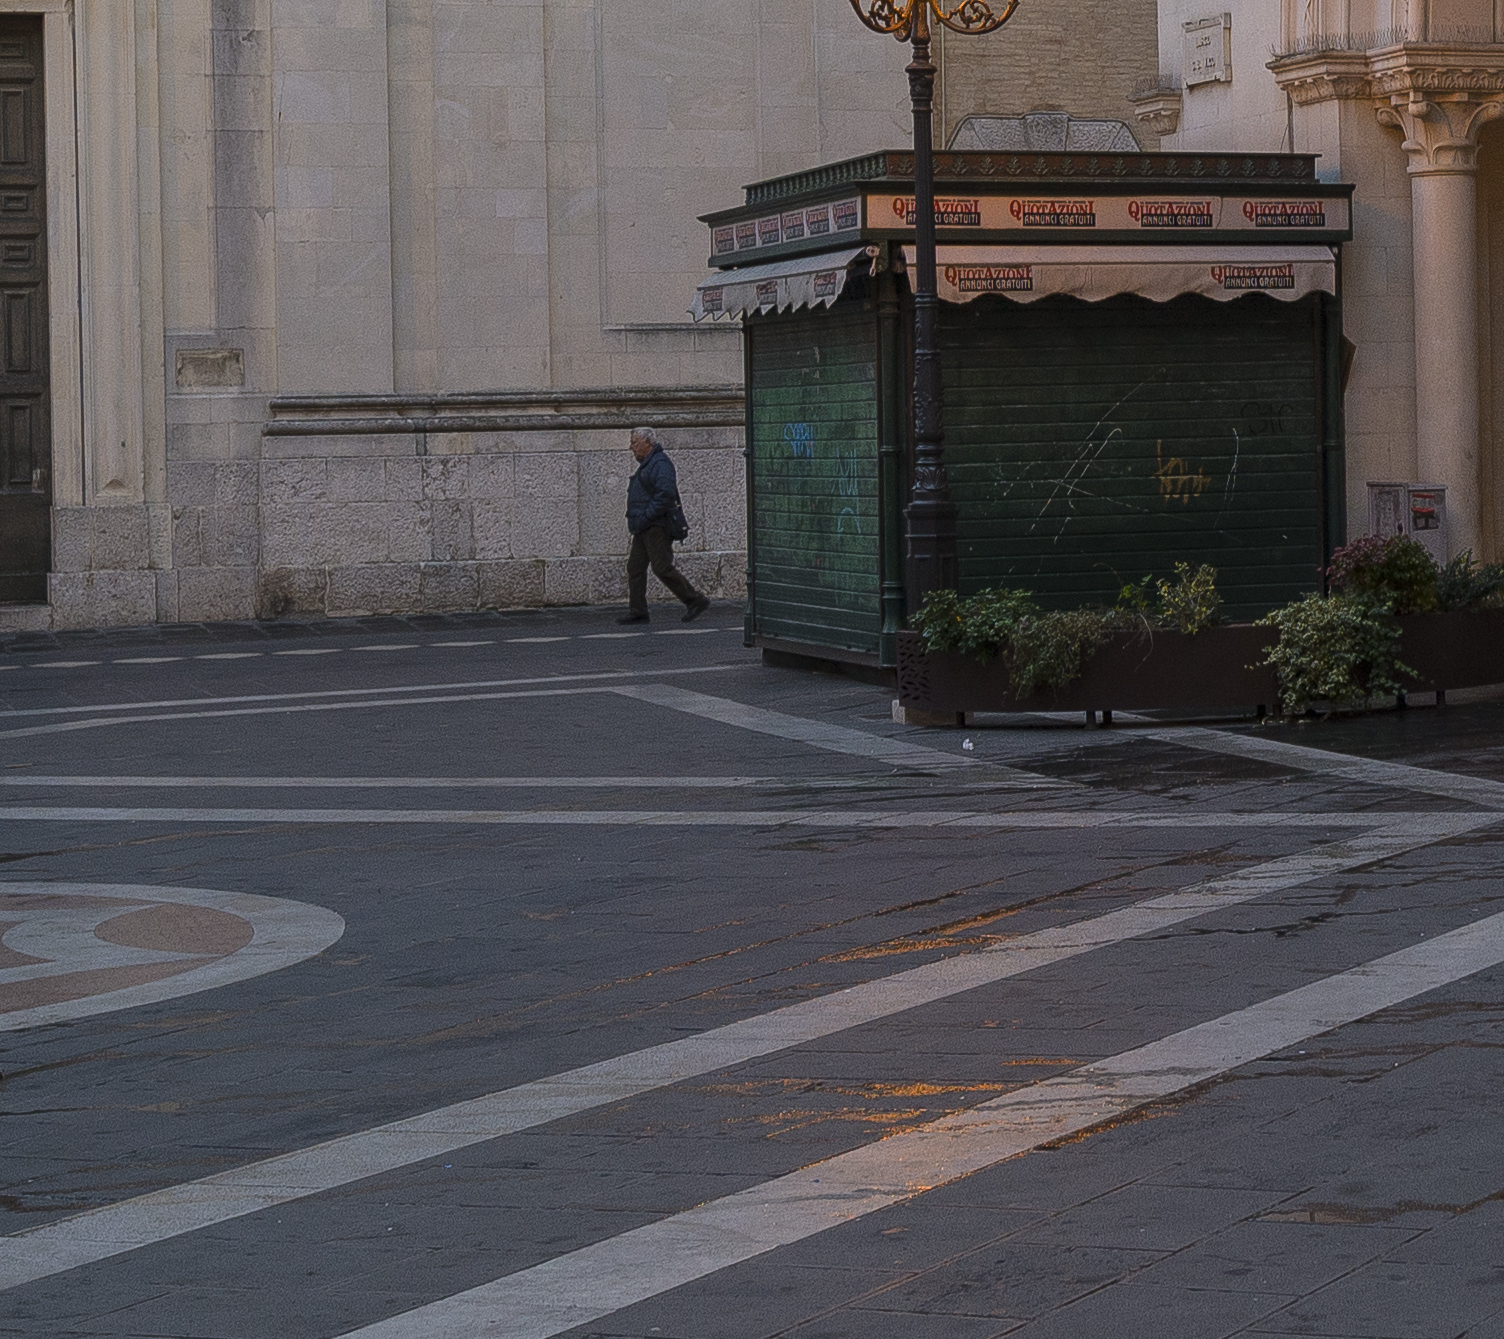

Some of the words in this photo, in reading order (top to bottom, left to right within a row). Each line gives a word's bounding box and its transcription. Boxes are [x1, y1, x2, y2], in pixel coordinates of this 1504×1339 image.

[943, 213, 979, 224] GRATUITI
[1024, 214, 1058, 226] ANNUNCI
[1058, 214, 1094, 226] GRATUITI
[1141, 215, 1175, 226] ANNUNCI
[1175, 215, 1211, 226] GRATUITI
[1256, 215, 1289, 226] ANNUNCI
[1289, 215, 1324, 226] GRATUITI
[959, 279, 995, 291] ANNUNCI
[995, 279, 1031, 290] GRATUITI
[1224, 277, 1258, 288] ANNUNCI
[1258, 276, 1293, 288] GRATUITI
